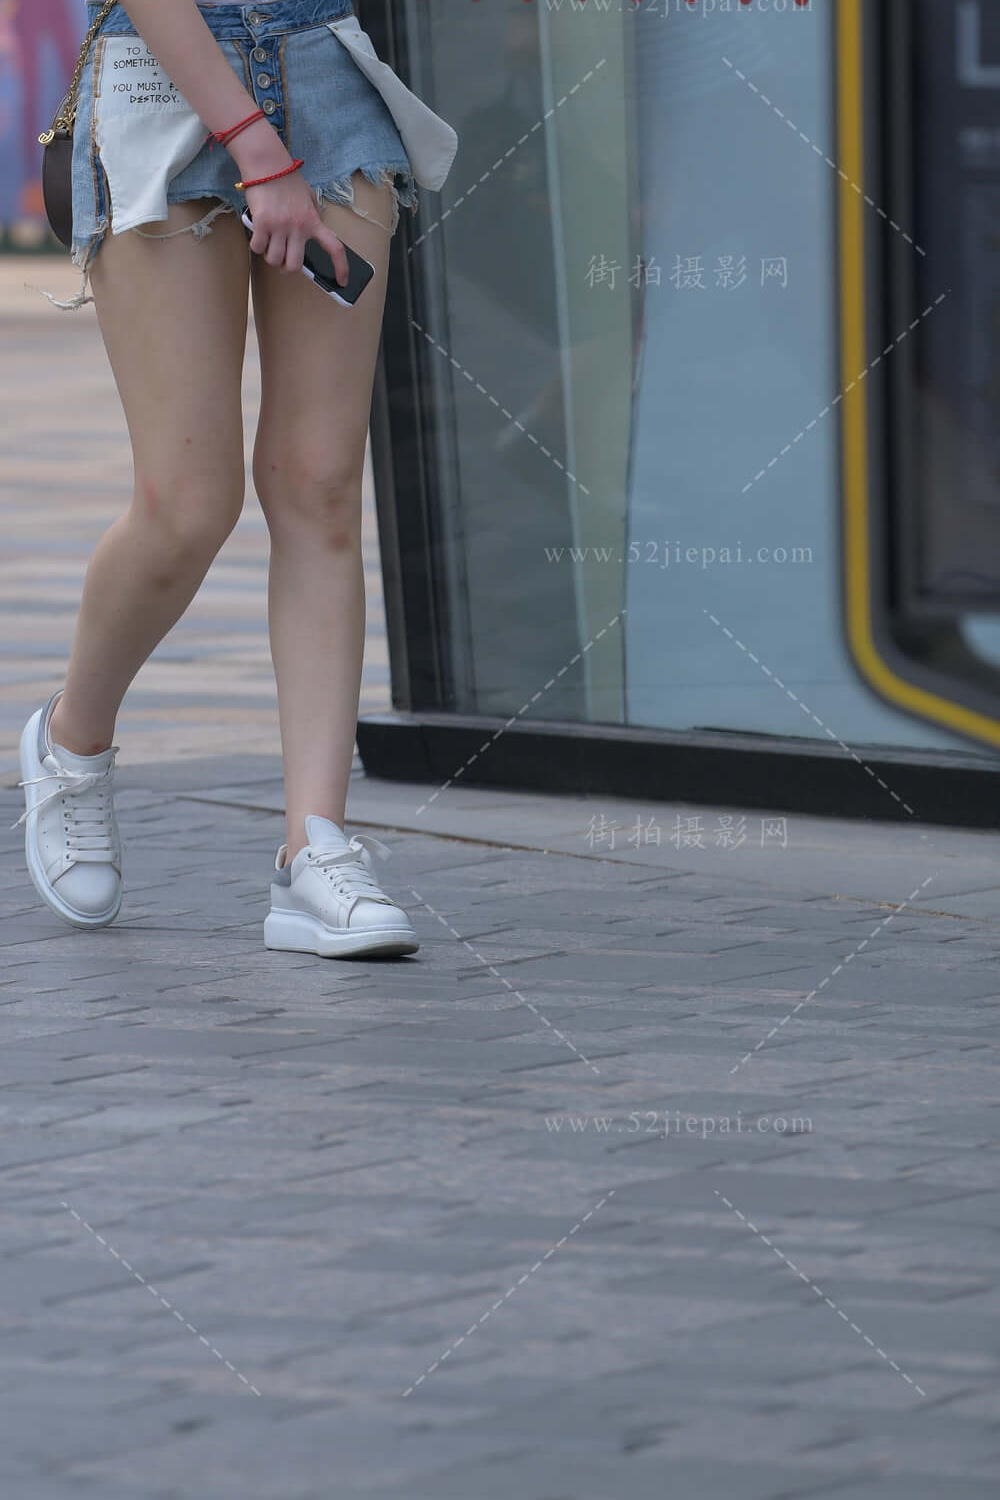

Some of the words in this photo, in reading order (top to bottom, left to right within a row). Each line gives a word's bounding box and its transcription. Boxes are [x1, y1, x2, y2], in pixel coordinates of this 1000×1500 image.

[126, 46, 141, 56] TO
[113, 58, 159, 70] SOMETHI
[112, 83, 132, 93] YOU
[137, 81, 163, 91] MUST
